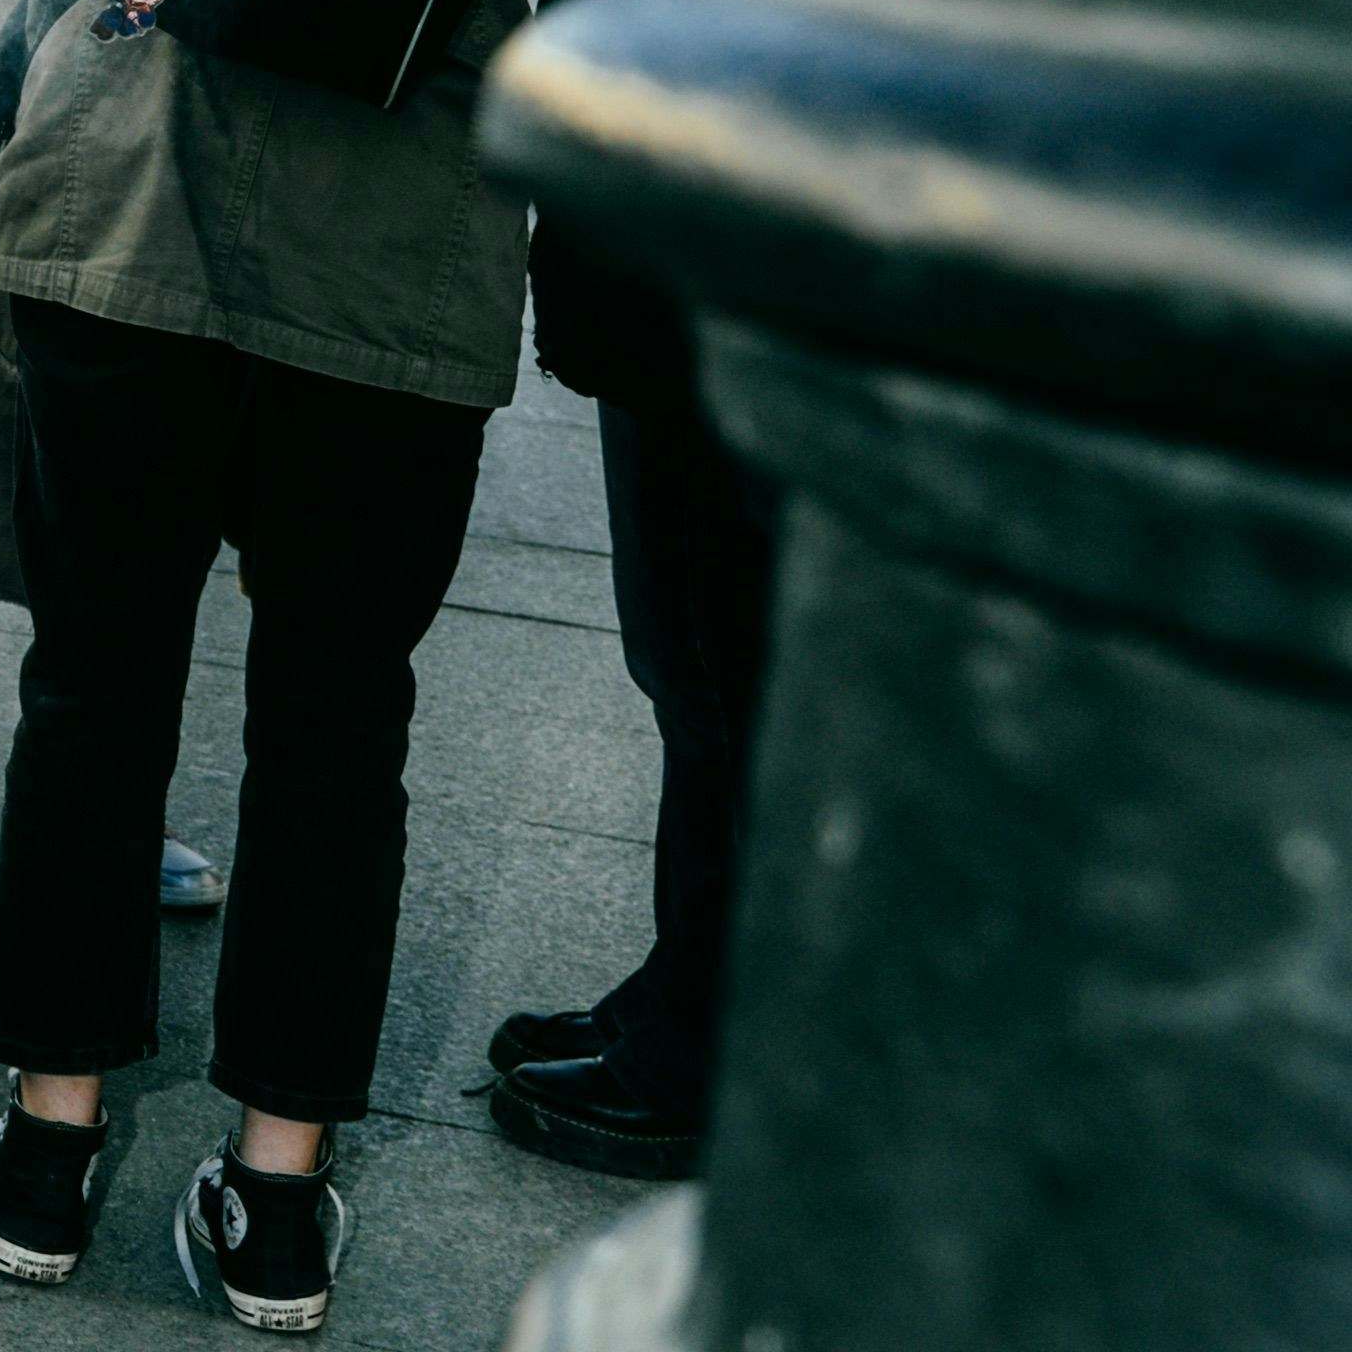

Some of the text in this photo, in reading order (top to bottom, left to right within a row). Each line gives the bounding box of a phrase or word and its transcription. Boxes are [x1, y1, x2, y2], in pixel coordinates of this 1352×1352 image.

[17, 1256, 60, 1269] CONVERSE
[15, 1264, 58, 1282] ALL STAR
[259, 1306, 304, 1315] CONVERSE
[260, 1314, 304, 1328] ALL STAR
